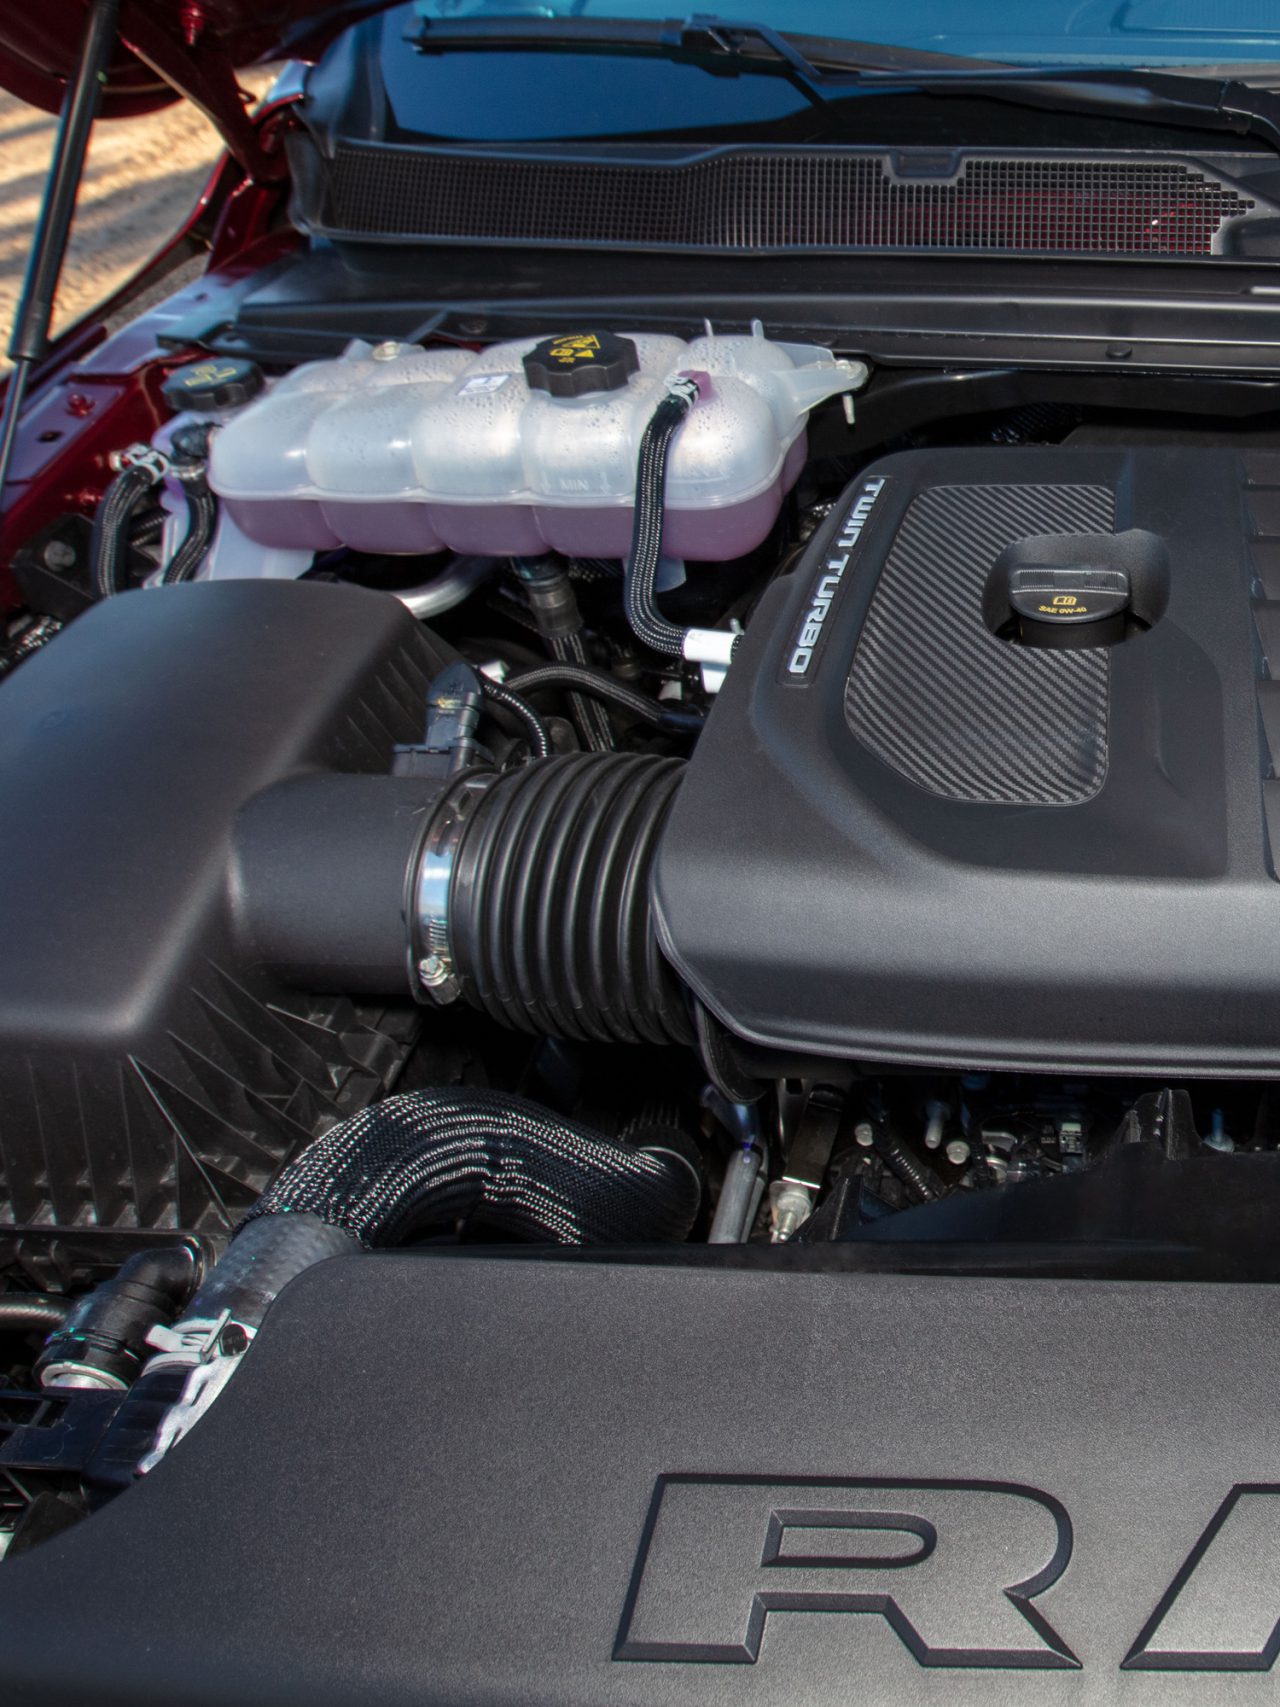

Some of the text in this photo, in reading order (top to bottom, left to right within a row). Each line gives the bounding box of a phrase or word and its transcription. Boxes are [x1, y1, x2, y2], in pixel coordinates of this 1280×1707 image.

[559, 479, 589, 491] MIN
[788, 479, 885, 674] TWIN TURBO
[1039, 605, 1057, 614] SAE
